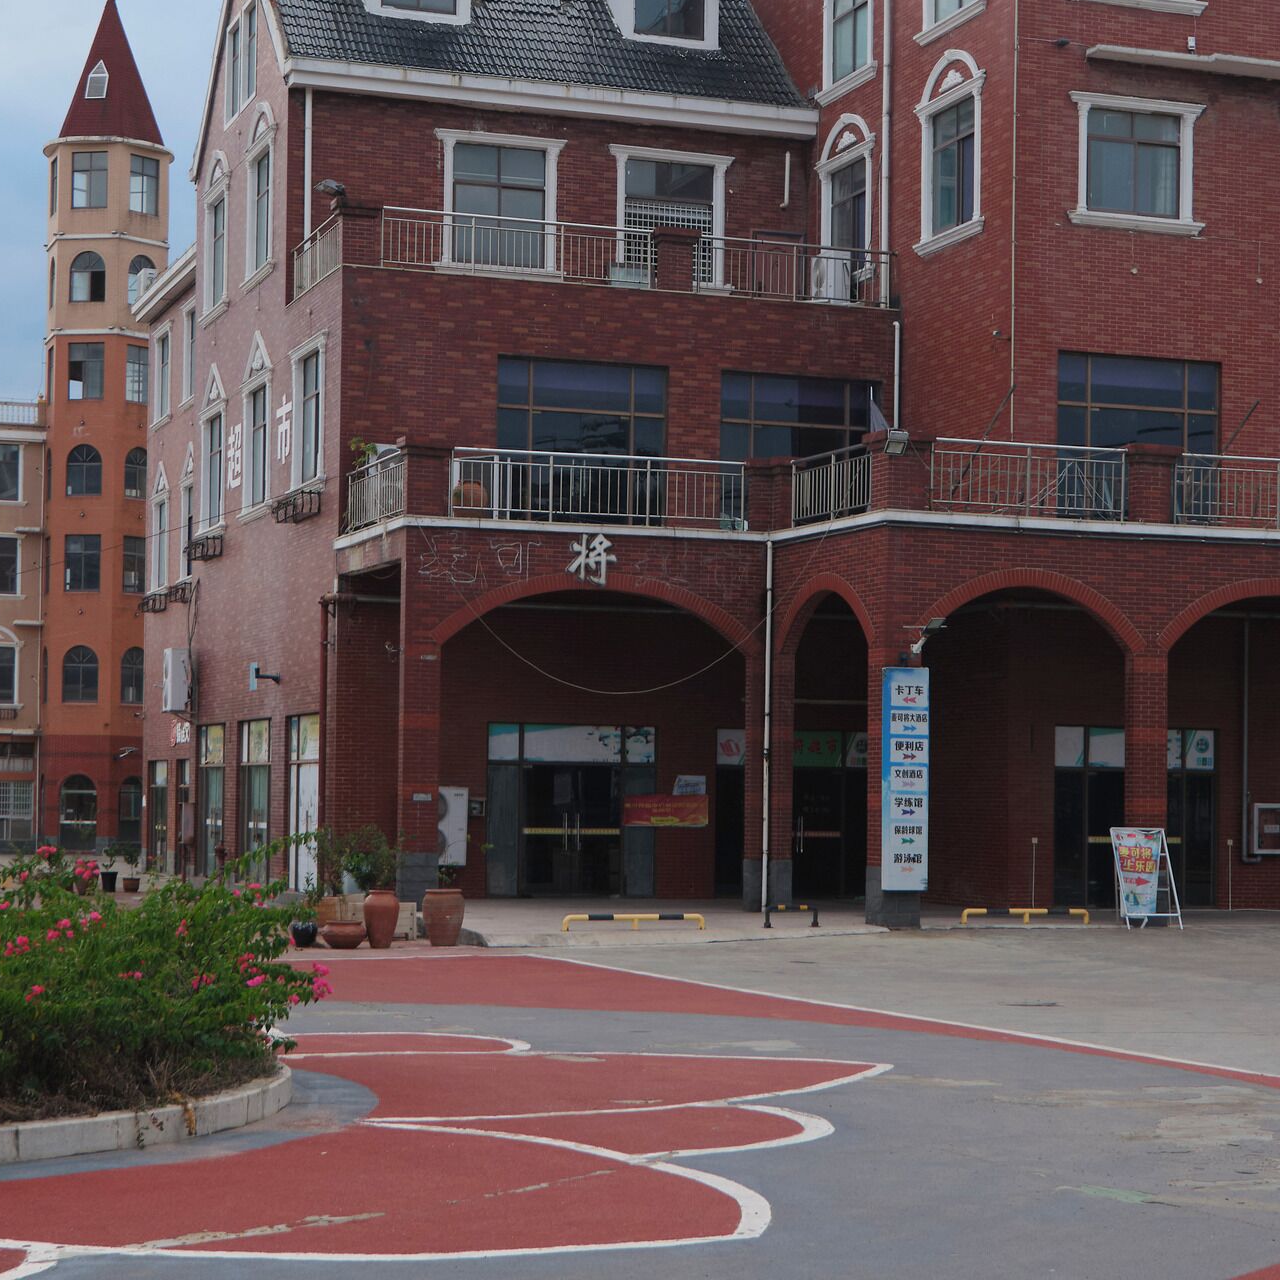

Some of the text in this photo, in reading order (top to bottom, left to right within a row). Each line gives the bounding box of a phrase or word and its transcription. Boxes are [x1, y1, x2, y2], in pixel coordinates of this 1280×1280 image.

[895, 685, 924, 696] 卡丁车
[891, 713, 928, 723] 麦可将大酒店
[895, 741, 924, 751] 便利店
[894, 769, 923, 779] 文创酒店
[894, 797, 923, 808] 学练馆
[894, 825, 923, 835] 保龄球馆
[893, 853, 922, 864] 游泳馆
